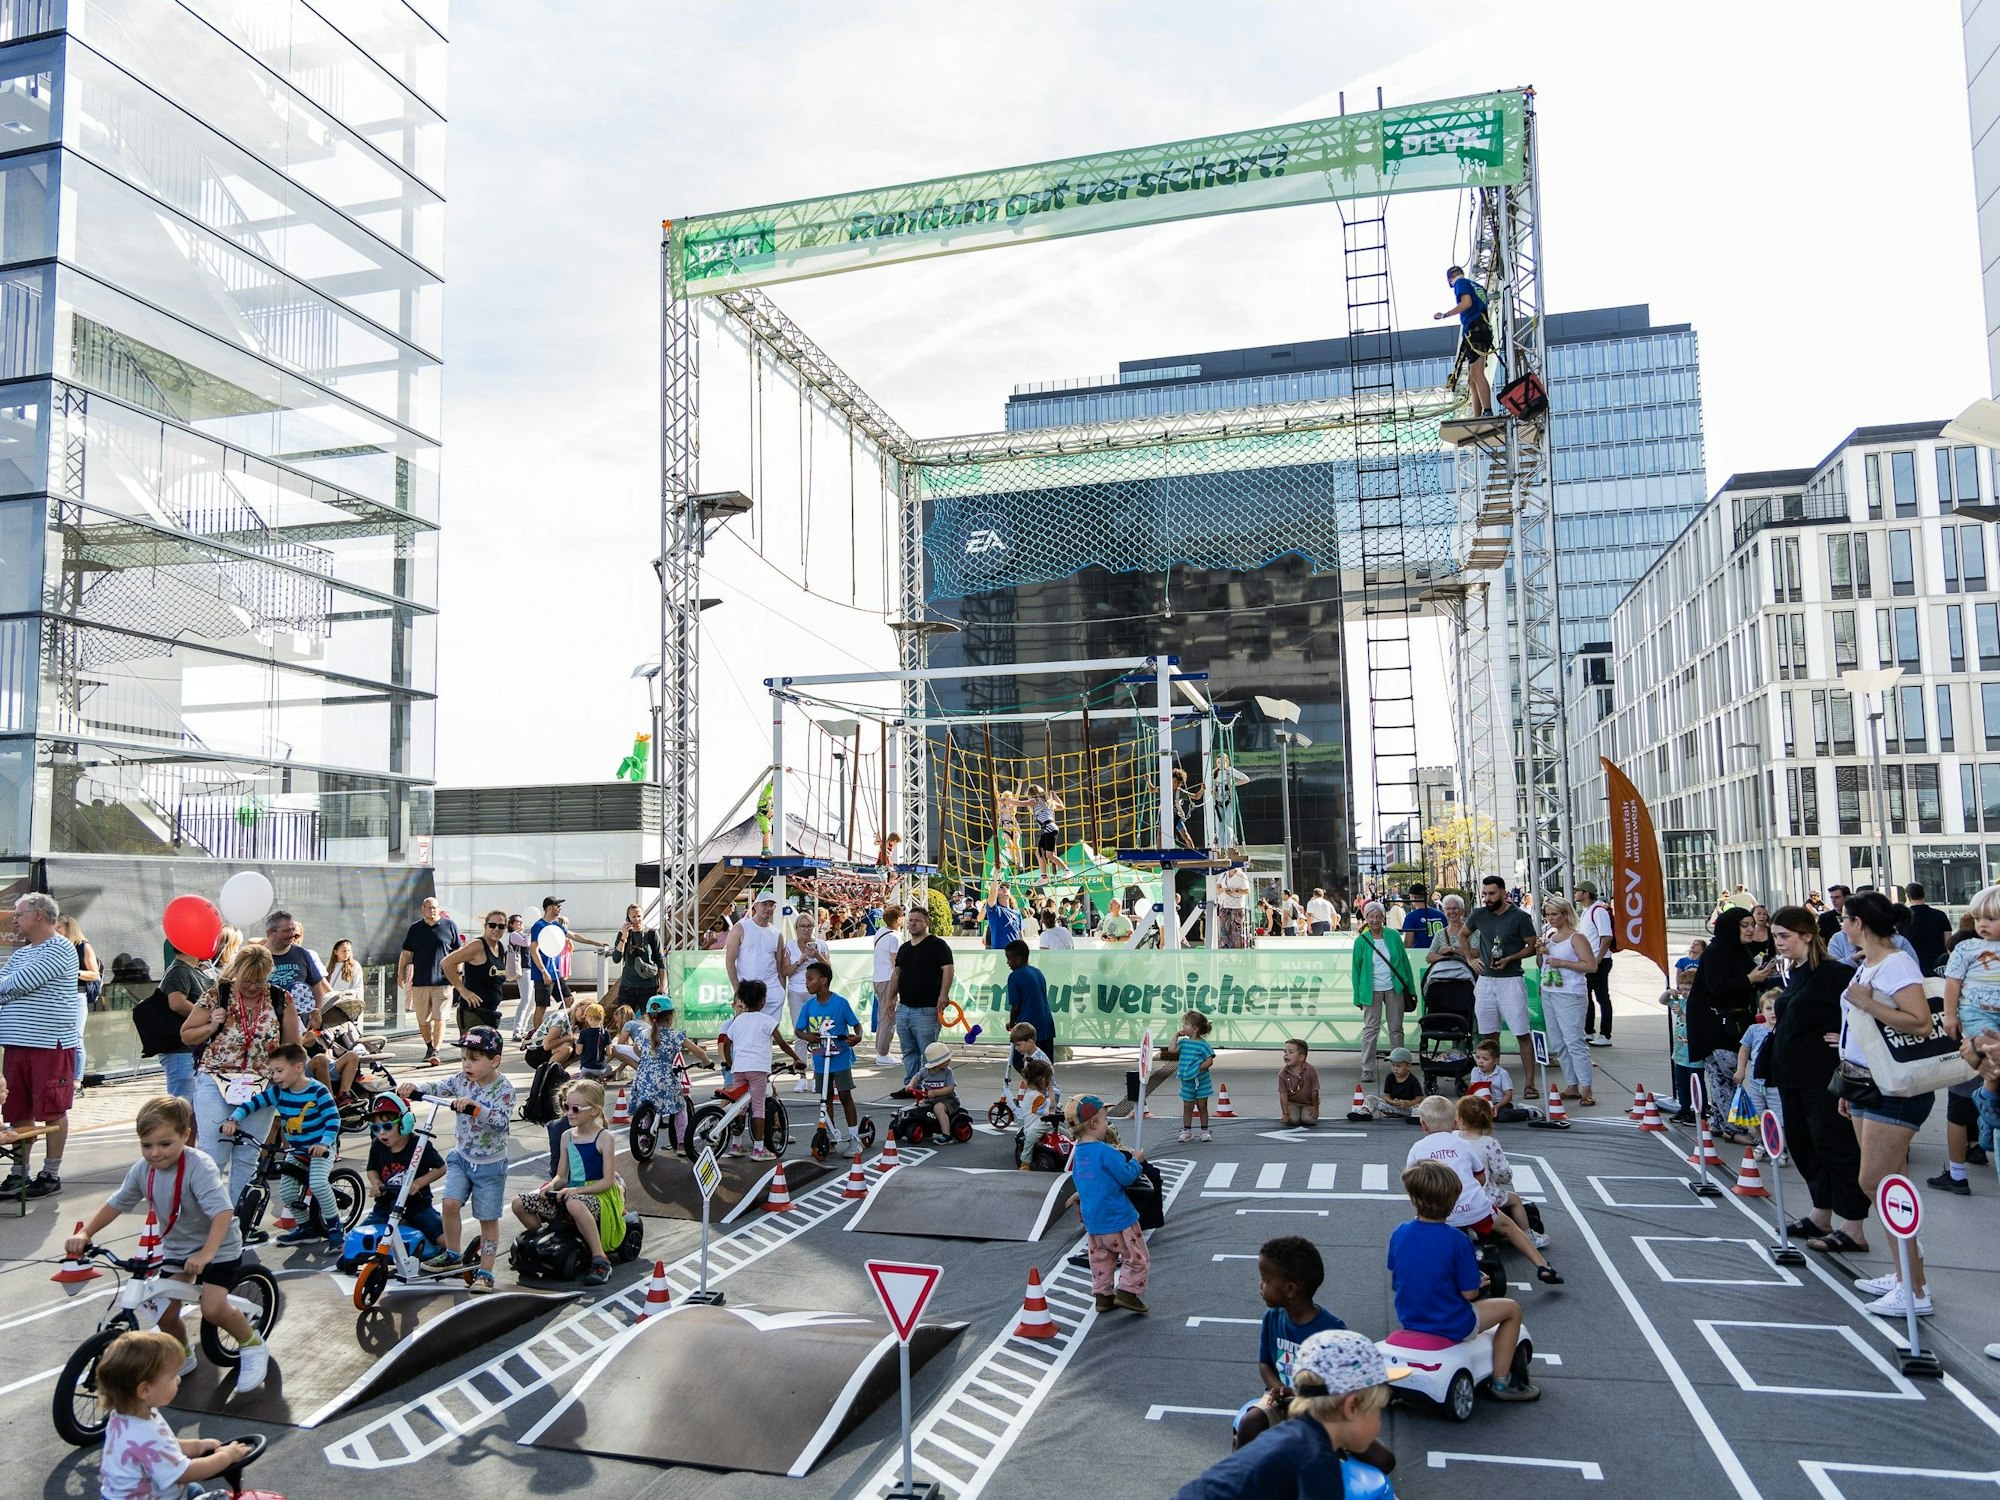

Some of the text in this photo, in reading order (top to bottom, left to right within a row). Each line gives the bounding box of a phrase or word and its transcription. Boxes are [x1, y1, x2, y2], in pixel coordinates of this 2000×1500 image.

[1401, 126, 1483, 155] DEVK
[1005, 179, 1070, 226] gut
[1076, 142, 1289, 205] versichert!
[965, 529, 1007, 553] EA
[1630, 799, 1640, 863] unterwegs
[1917, 850, 1979, 859] PORCELANOSA
[1625, 867, 1643, 945] acv
[698, 984, 729, 1004] DE
[1047, 974, 1091, 1014] ut
[1097, 972, 1323, 1016] versichert!
